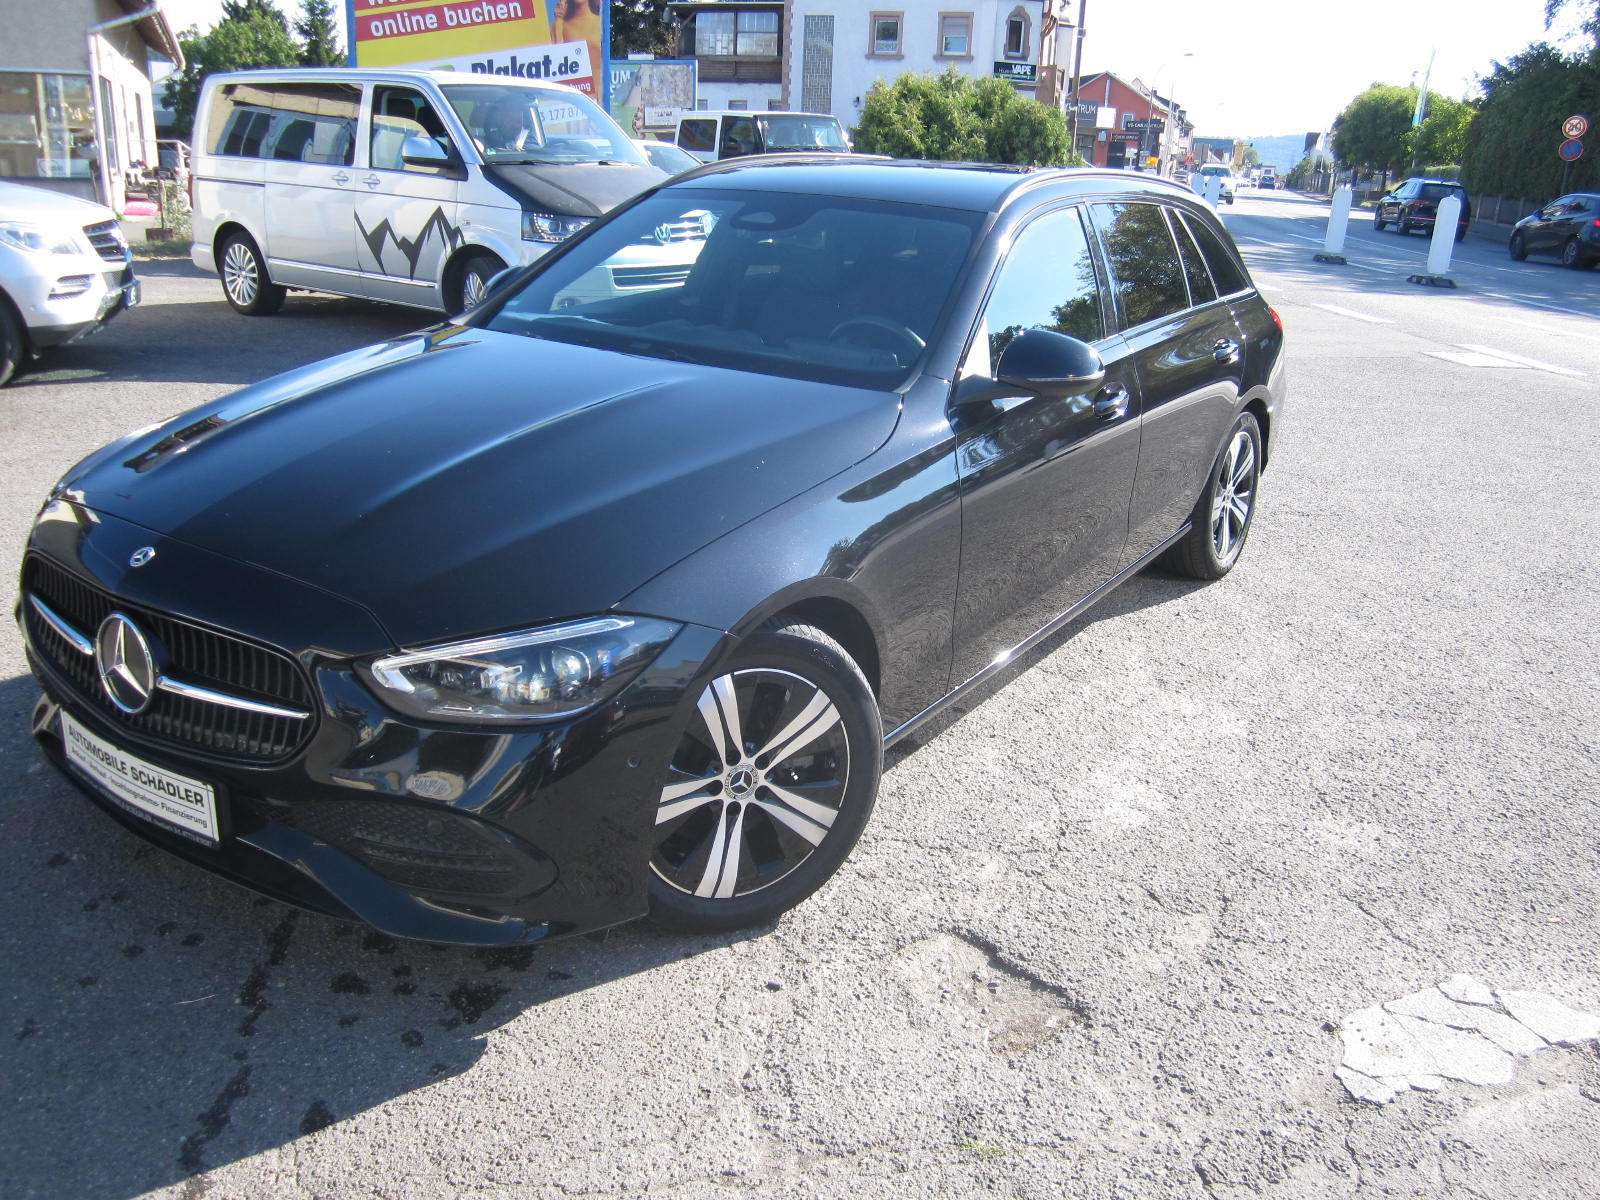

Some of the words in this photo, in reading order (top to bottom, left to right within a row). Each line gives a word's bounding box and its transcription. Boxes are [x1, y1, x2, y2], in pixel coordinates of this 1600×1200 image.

[370, 12, 438, 37] online
[443, 1, 523, 27] buchen
[68, 725, 128, 775] AUTOMOBILE
[130, 766, 205, 808] SCHÄDLER
